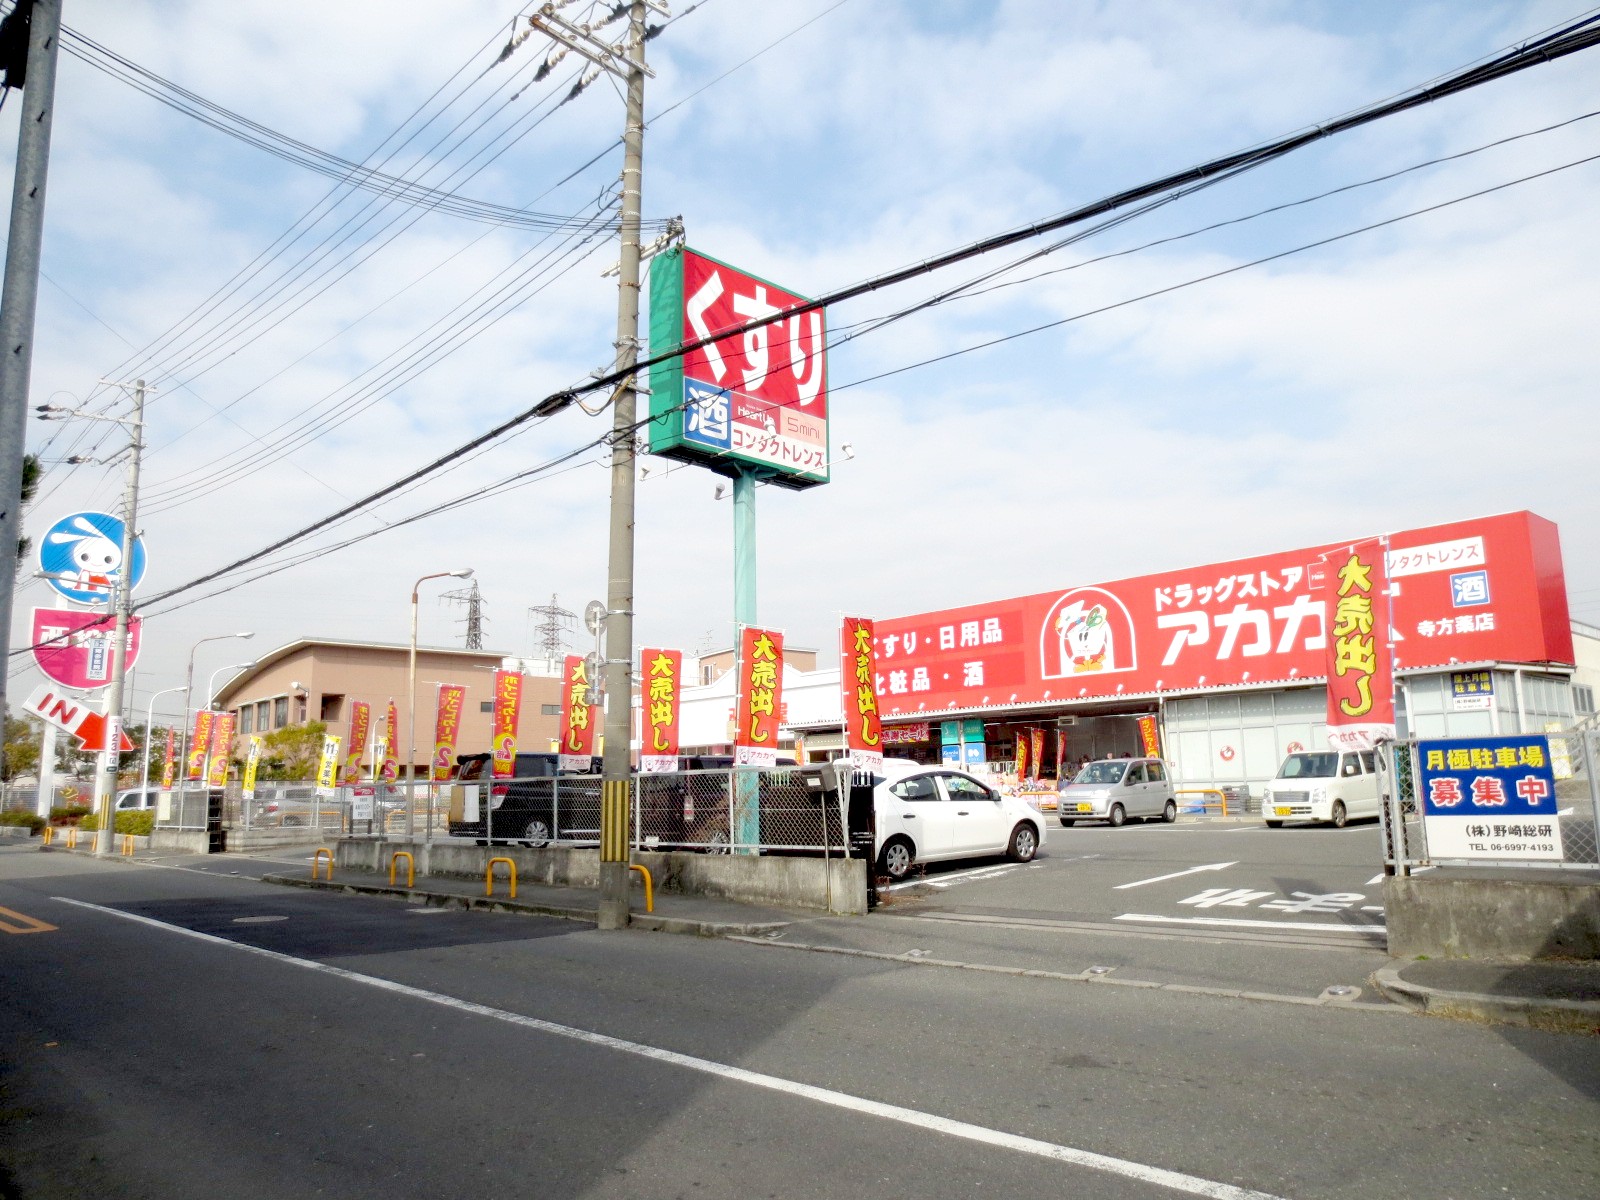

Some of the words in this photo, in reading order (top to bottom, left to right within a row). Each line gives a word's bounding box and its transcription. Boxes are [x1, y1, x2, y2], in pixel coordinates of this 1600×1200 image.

[686, 270, 822, 406] くすり
[688, 386, 729, 441] 酒
[733, 429, 824, 467] コンタクトレンズ
[1154, 566, 1304, 611] ドラッグストア
[1455, 575, 1488, 604] 酒
[1416, 612, 1495, 638] 寺方薬店
[749, 633, 777, 744] 大売出し
[854, 622, 879, 746] 大売出し
[37, 692, 79, 725] IN
[650, 653, 674, 751] 大売出し
[1426, 746, 1545, 770] 月極駐車場
[1429, 775, 1548, 807] 募集中
[1465, 824, 1552, 838] (株)野崎総研
[1469, 843, 1487, 851] TEL
[1490, 843, 1554, 852] 06-6997-4193
